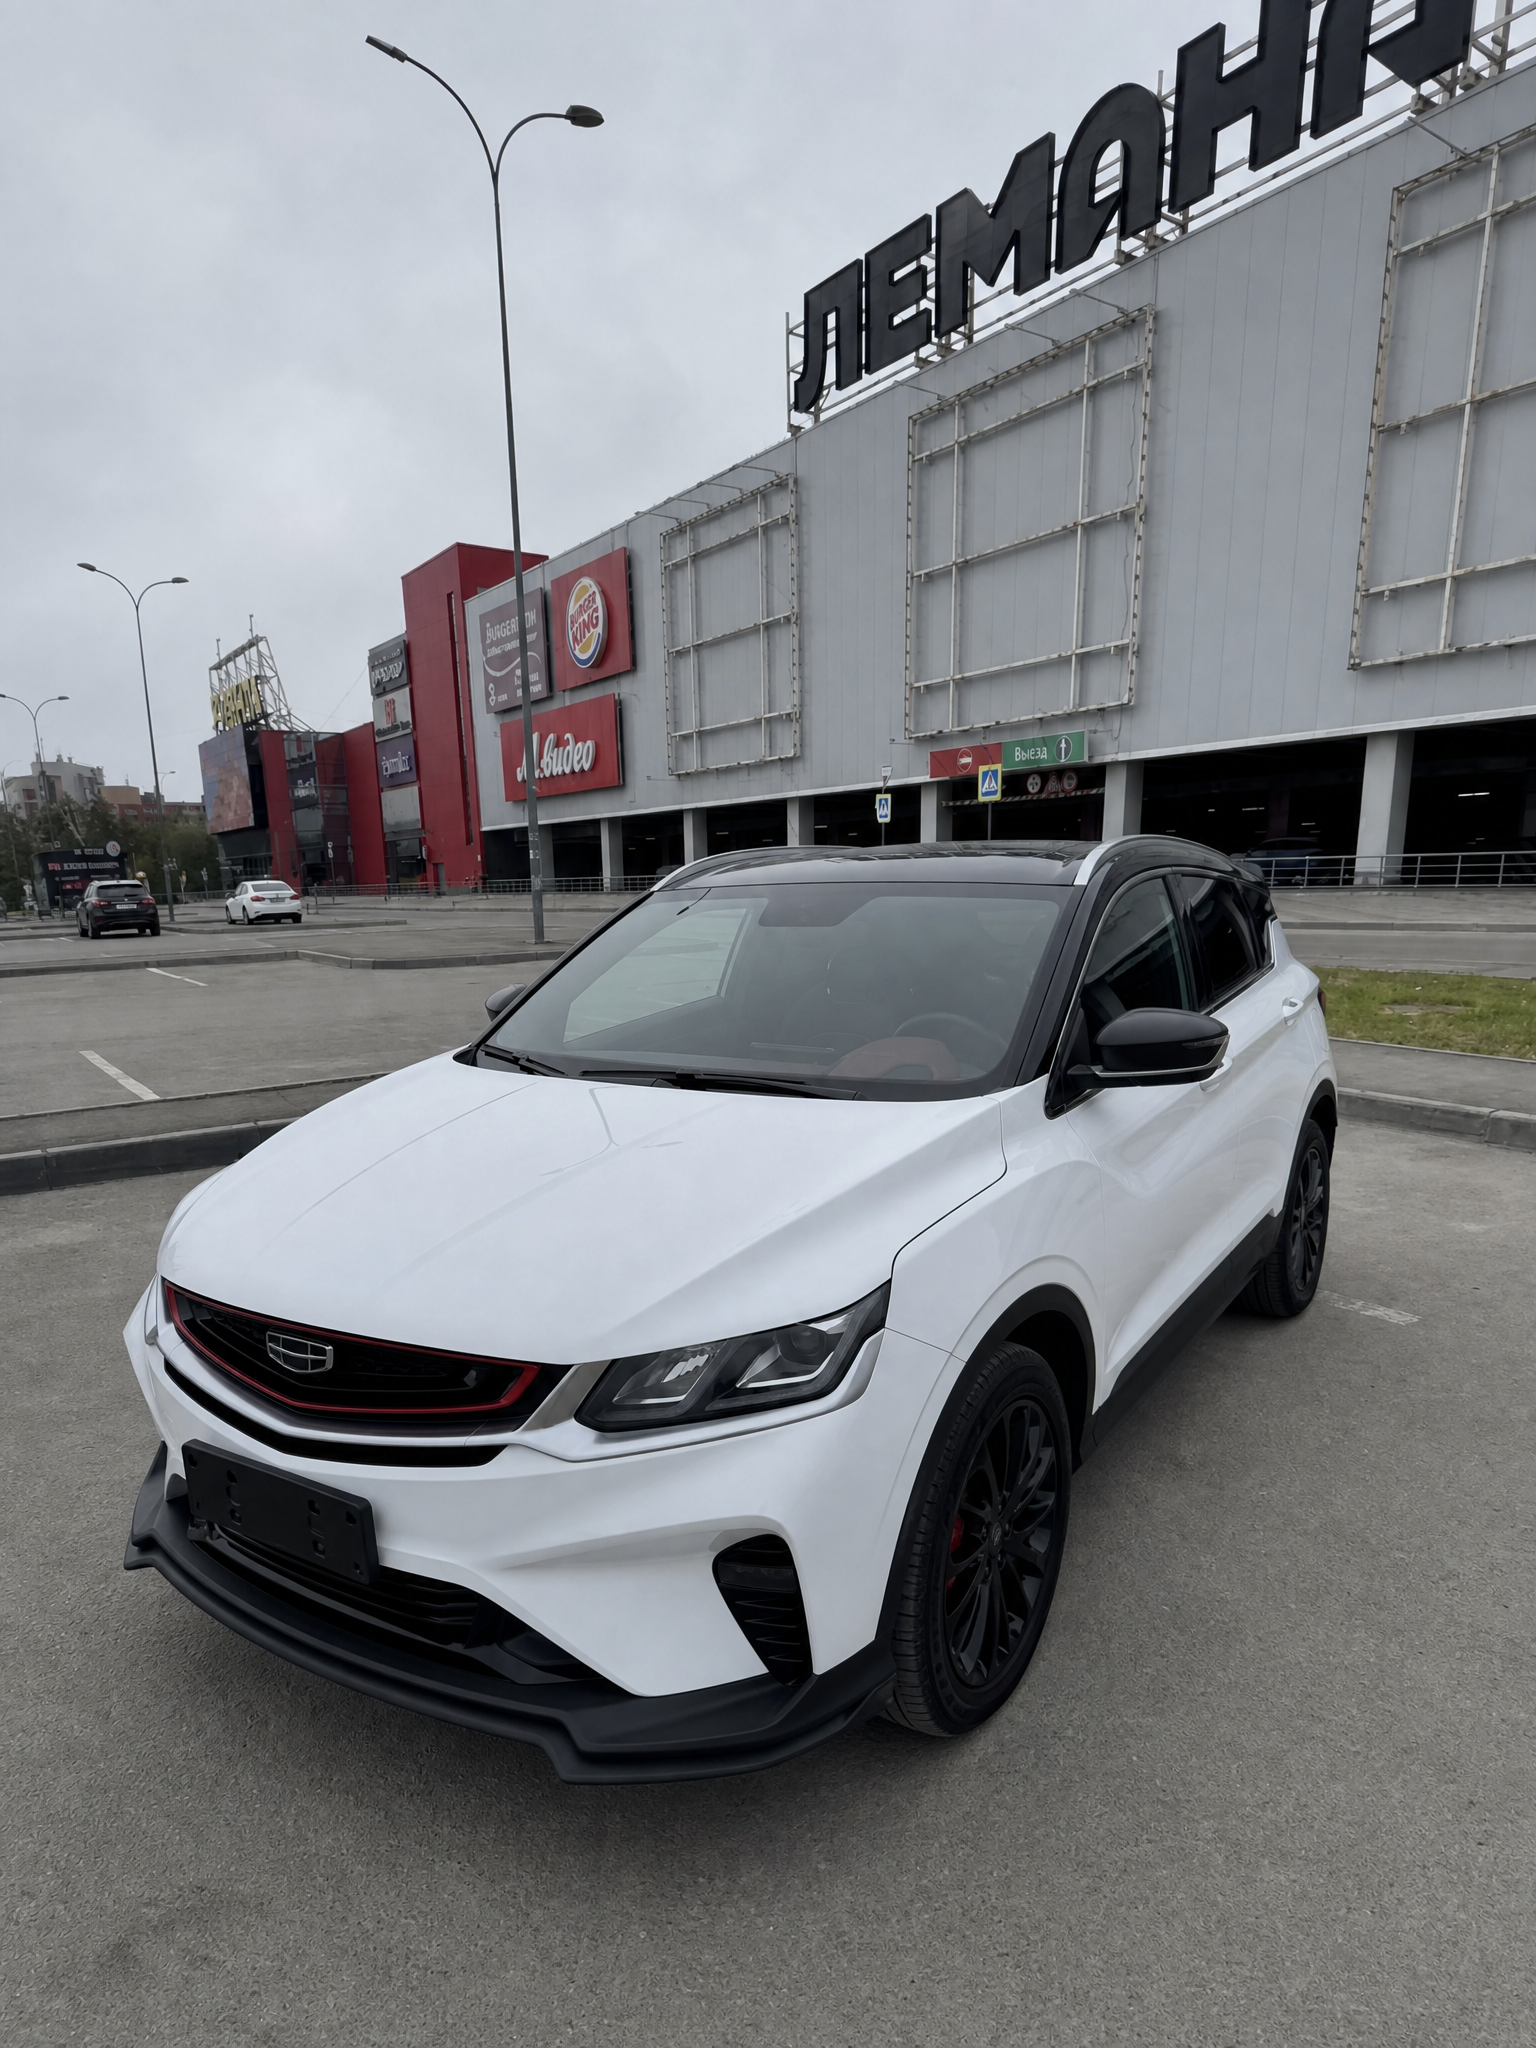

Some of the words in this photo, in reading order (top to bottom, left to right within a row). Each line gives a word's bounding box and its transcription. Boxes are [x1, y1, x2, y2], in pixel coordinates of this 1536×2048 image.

[569, 590, 597, 631] BURGER
[571, 605, 599, 652] KING
[517, 731, 596, 783] М.видео
[1015, 746, 1047, 762] Выезд
